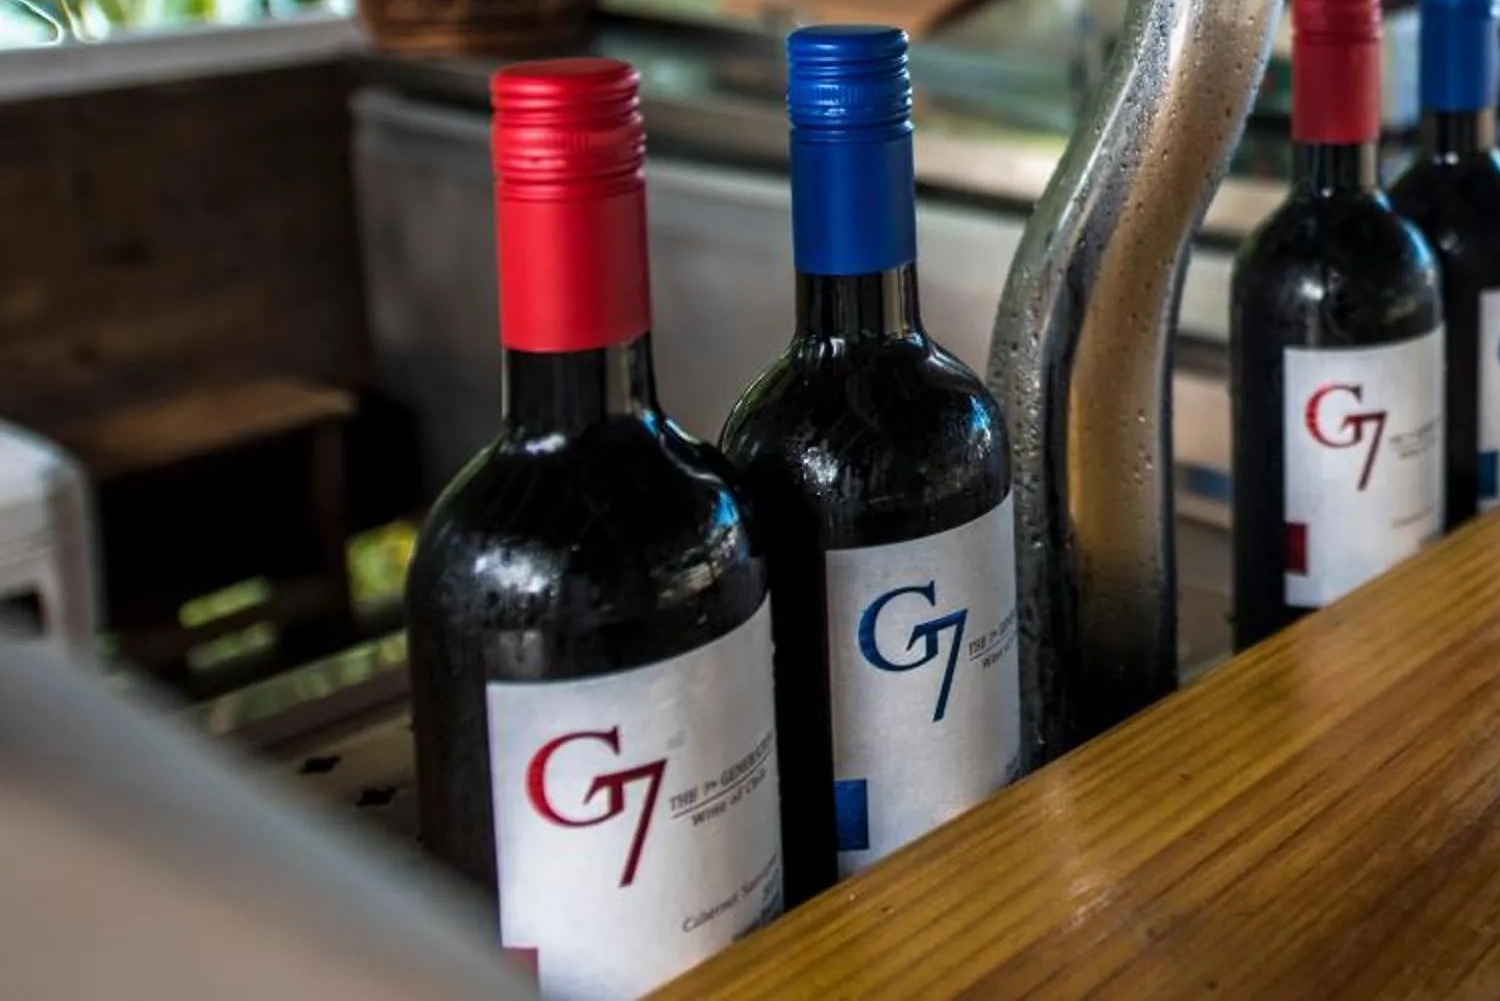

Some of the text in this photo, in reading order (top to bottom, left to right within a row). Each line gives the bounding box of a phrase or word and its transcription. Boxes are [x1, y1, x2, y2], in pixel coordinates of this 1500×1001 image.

[1304, 383, 1389, 492] G7
[858, 579, 969, 723] G7
[525, 726, 668, 887] G7
[669, 786, 699, 812] THE
